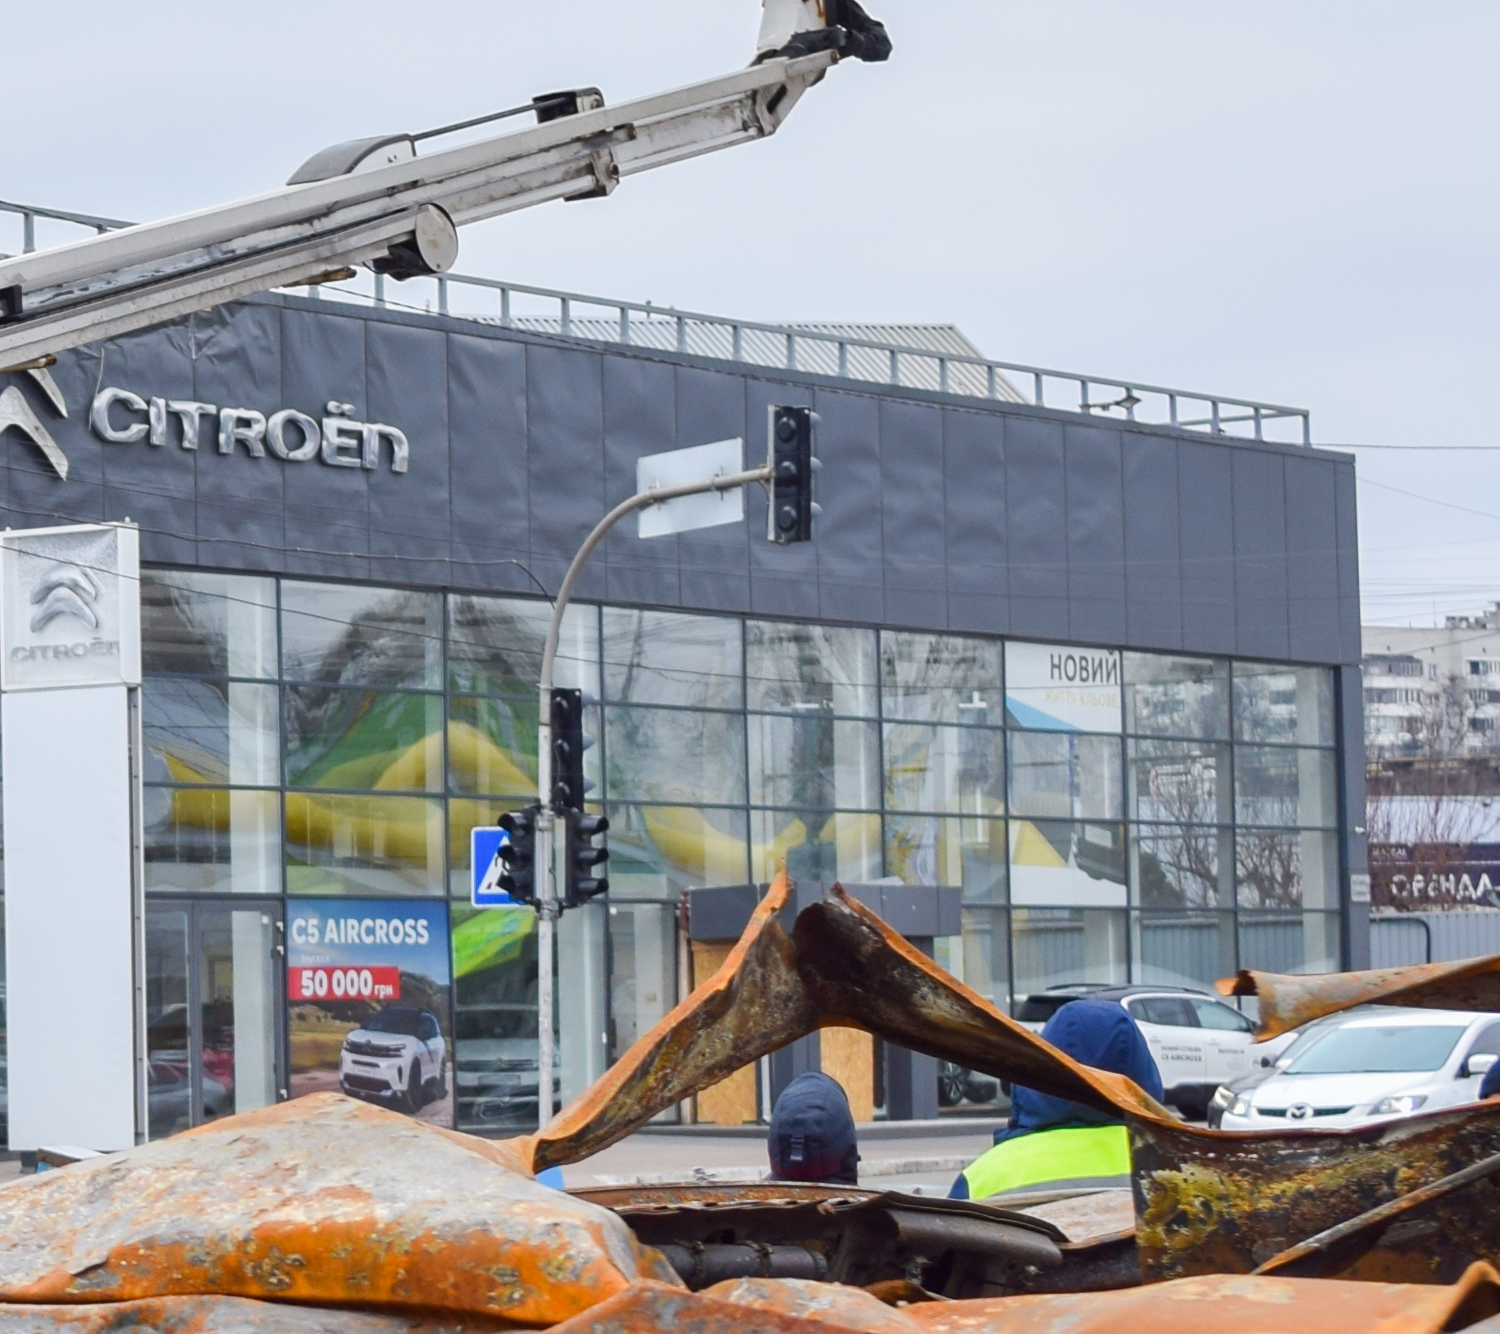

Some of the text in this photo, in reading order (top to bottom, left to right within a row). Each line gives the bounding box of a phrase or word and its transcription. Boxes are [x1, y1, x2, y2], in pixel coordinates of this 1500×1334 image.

[90, 386, 409, 473] CITROËN
[1050, 650, 1118, 685] НОВИЙ
[292, 918, 429, 944] C5 AIRCROSS
[301, 969, 394, 999] 50 000 грн
